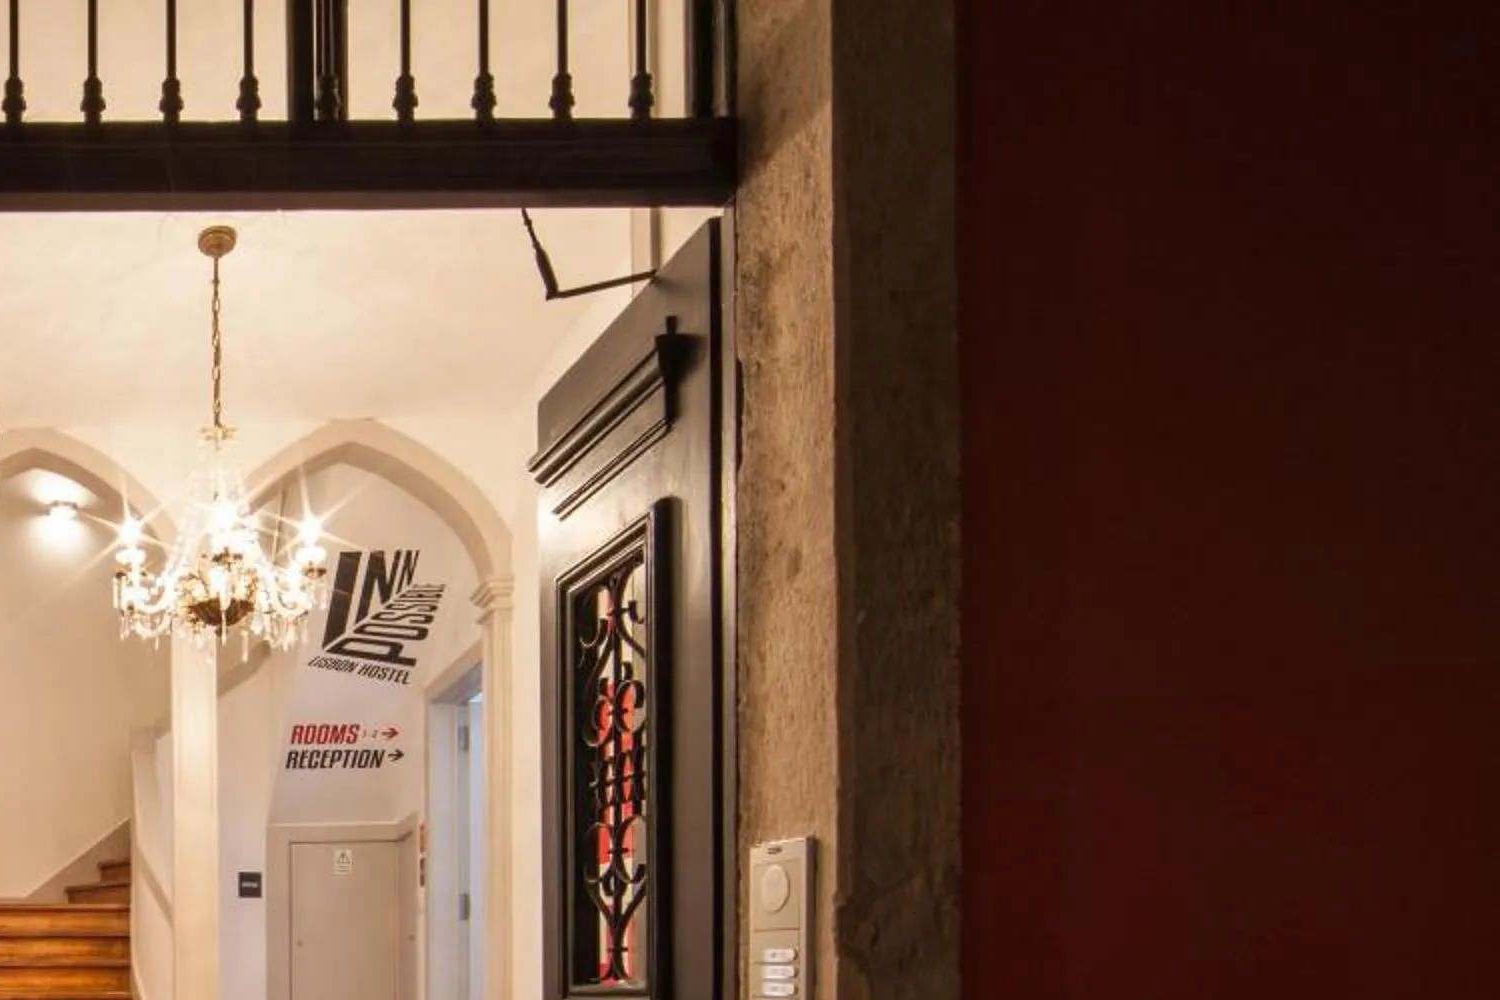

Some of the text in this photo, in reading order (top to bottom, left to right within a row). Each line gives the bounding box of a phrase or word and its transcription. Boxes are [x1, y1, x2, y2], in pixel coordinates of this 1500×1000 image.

[321, 549, 421, 650] INN
[307, 655, 412, 685] LISBON HOSTEL
[290, 723, 360, 745] ROOMS
[285, 748, 386, 769] RECEPTION
